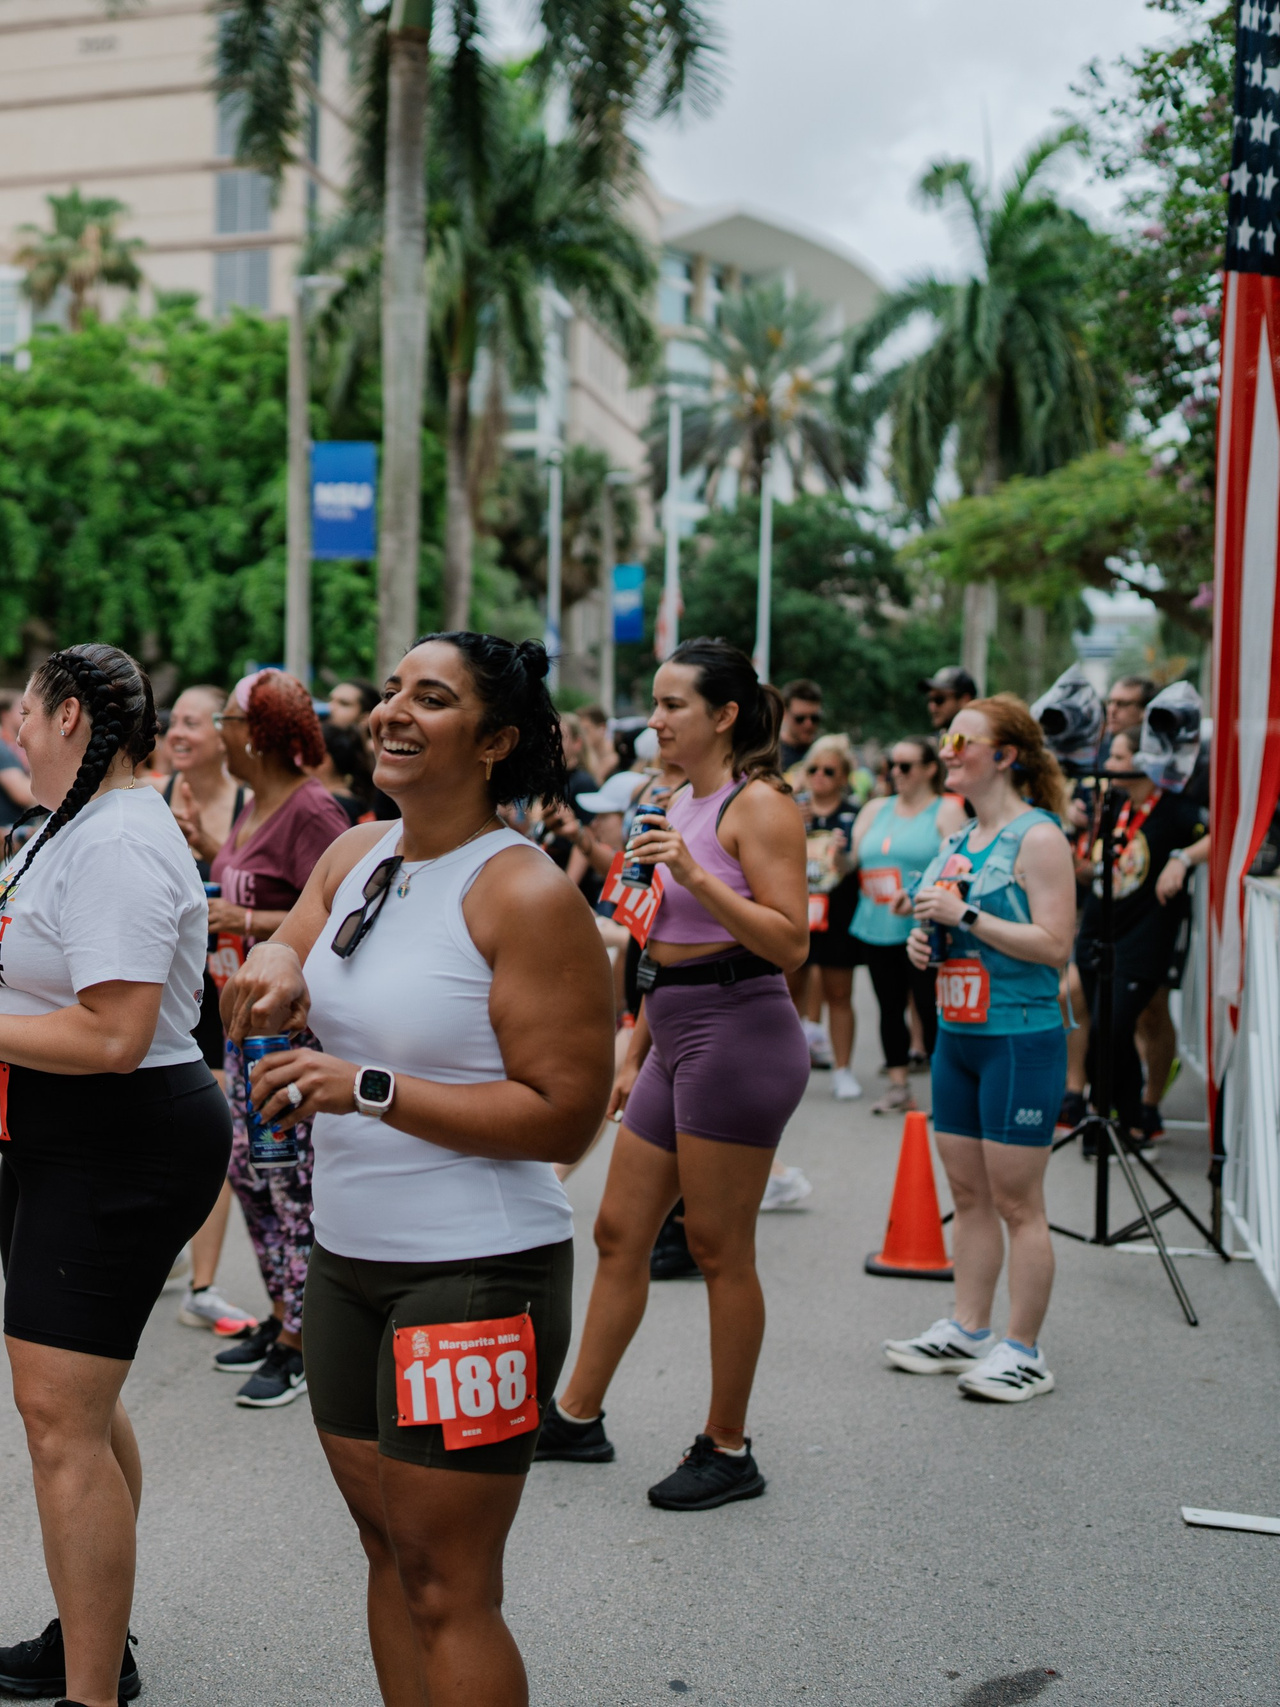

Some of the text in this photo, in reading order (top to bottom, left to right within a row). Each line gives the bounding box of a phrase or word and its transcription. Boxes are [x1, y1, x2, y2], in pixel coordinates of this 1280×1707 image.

[439, 1336, 495, 1350] Margarita
[498, 1333, 521, 1344] Mile
[404, 1350, 527, 1422] 1188
[510, 1416, 526, 1425] TACO
[462, 1428, 482, 1437] BEER
